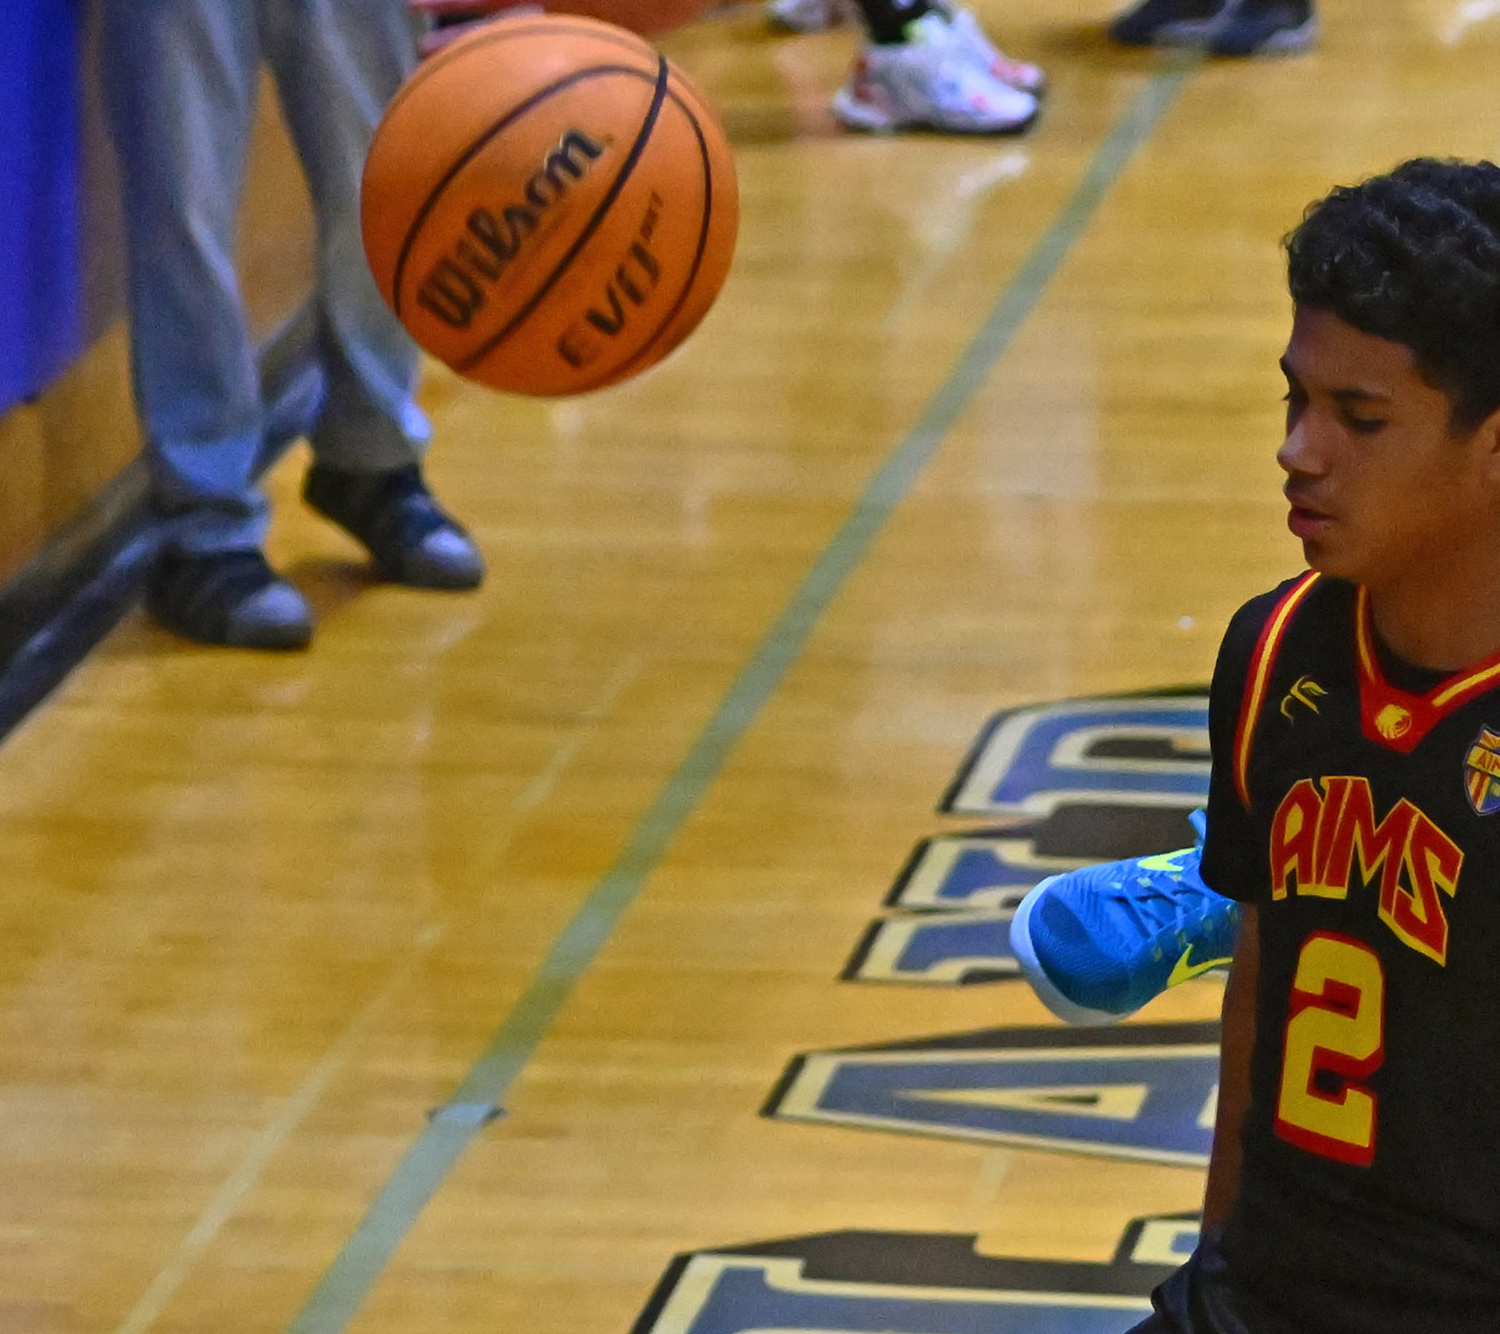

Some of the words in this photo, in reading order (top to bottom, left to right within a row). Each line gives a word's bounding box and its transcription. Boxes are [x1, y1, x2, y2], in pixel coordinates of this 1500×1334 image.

[416, 129, 604, 330] Wilson
[1269, 775, 1464, 967] AIMS
[1274, 929, 1386, 1167] 2
